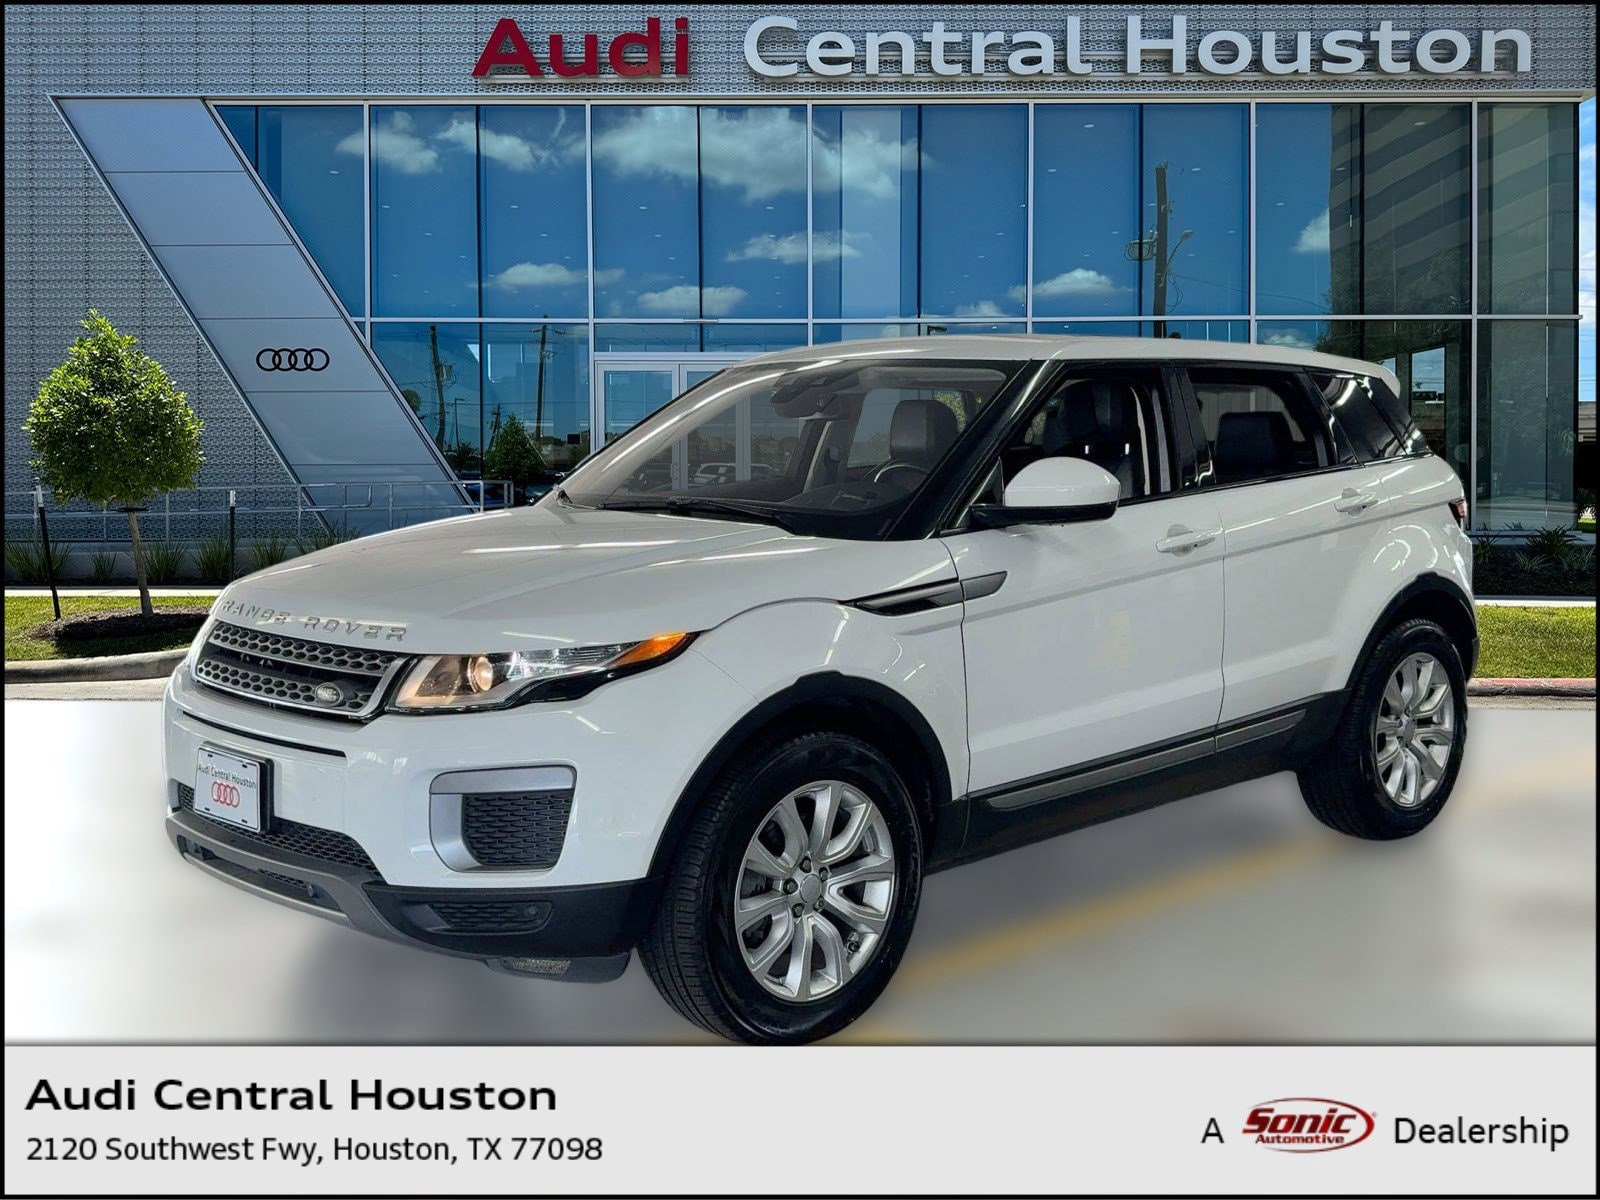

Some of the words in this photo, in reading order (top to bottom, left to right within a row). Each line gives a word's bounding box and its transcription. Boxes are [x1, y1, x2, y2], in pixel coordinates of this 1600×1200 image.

[473, 16, 691, 78] Audi
[743, 15, 1094, 76] Central
[1127, 14, 1533, 76] Houston
[222, 600, 290, 625] RANGE
[303, 616, 408, 641] ROVER
[198, 763, 210, 775] Audi
[211, 766, 231, 781] Central
[231, 774, 257, 789] Houston
